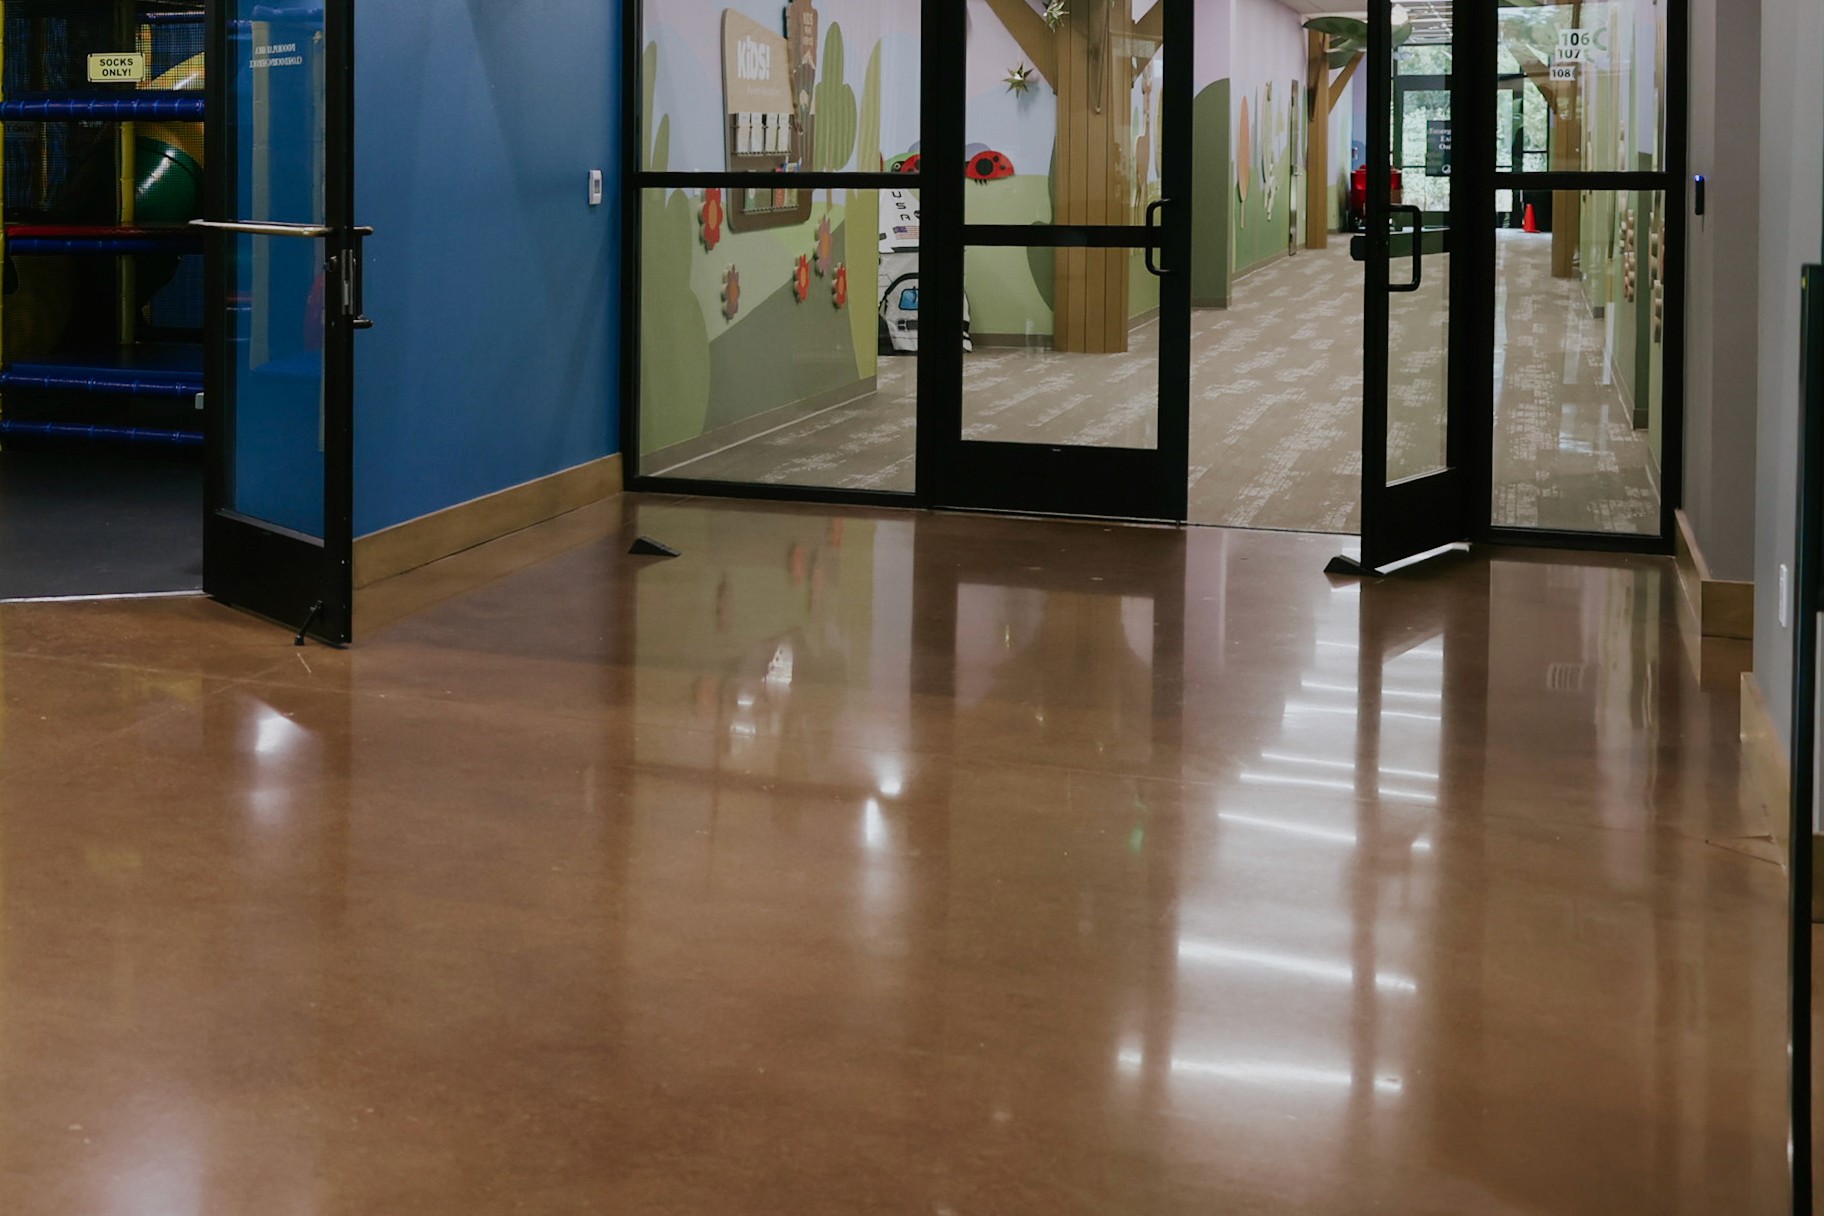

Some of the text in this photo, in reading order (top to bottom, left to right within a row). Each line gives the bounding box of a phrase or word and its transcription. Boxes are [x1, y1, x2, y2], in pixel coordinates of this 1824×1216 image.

[1561, 32, 1590, 46] 106
[1557, 49, 1581, 59] 107
[99, 58, 133, 67] SOCKS
[102, 68, 131, 77] ONLY!
[1551, 68, 1571, 78] 108
